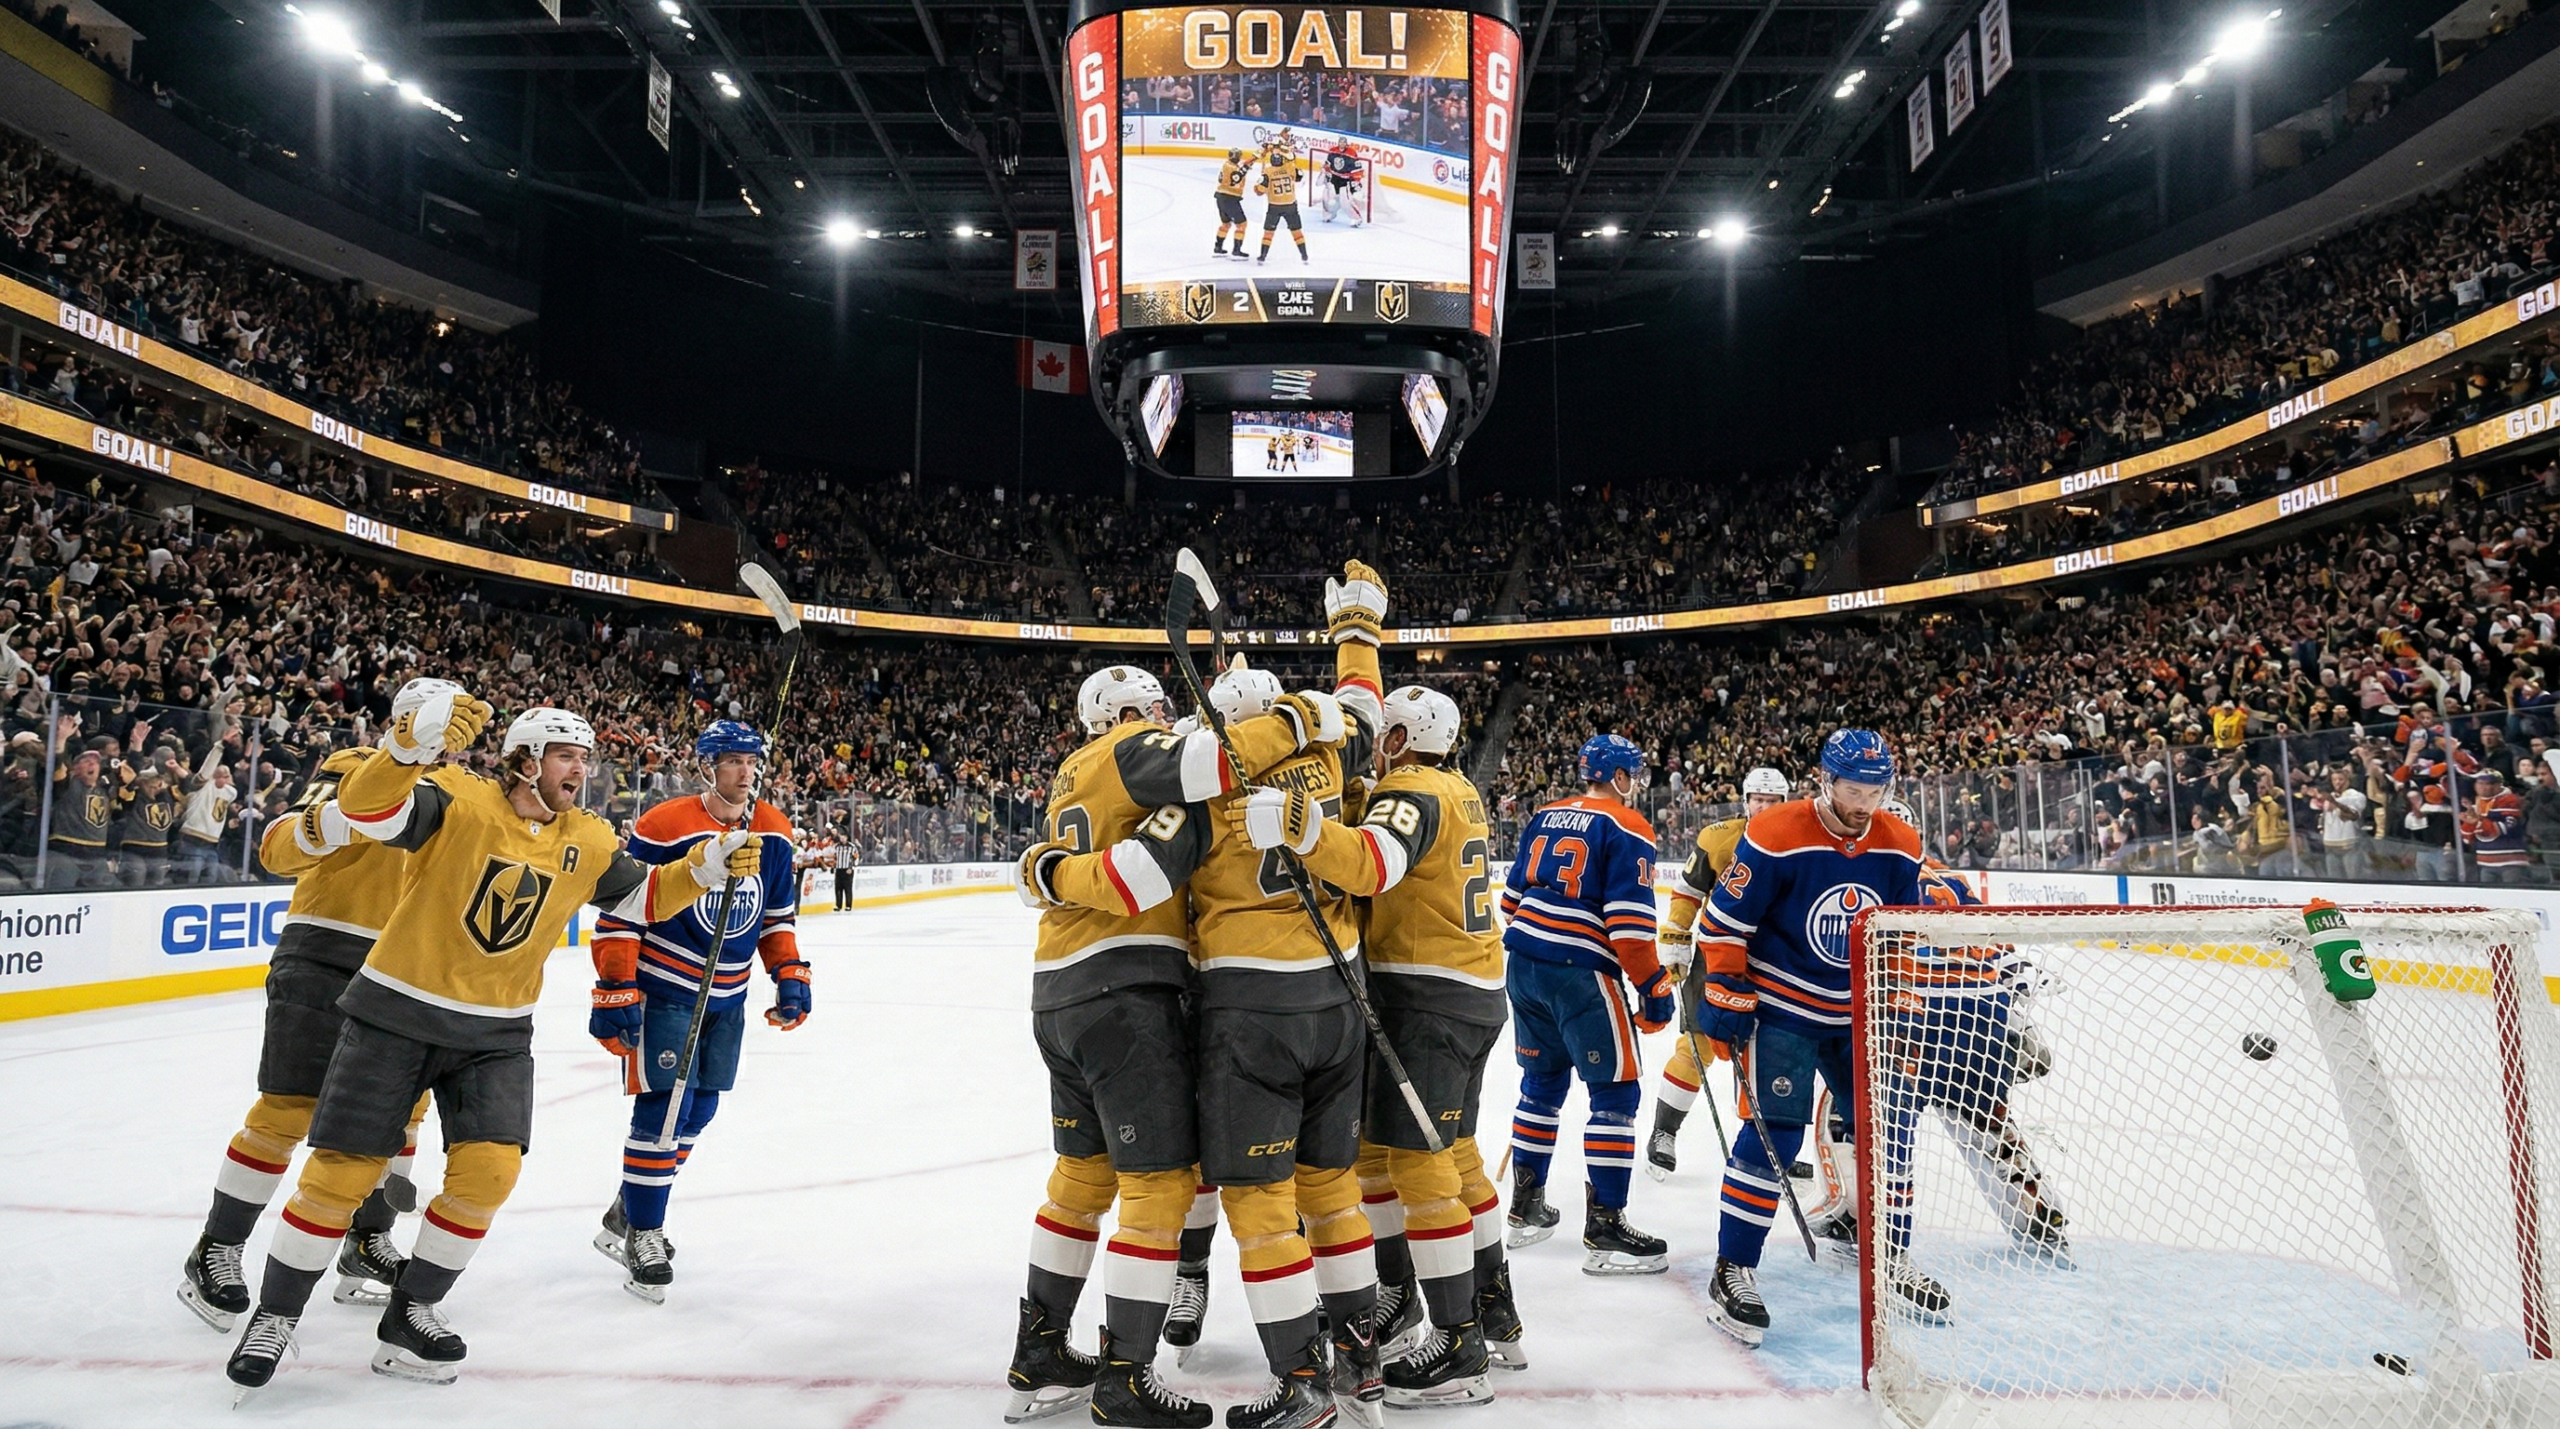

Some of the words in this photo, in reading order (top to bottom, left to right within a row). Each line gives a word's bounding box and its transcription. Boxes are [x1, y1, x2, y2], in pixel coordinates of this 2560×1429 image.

[1183, 9, 1408, 70] GOAL!
[1078, 51, 1115, 308] GOAL!
[1478, 51, 1511, 308] GOAL!
[1233, 292, 1249, 312] 2
[1342, 292, 1353, 312] 1
[2518, 280, 2560, 322] GO
[58, 301, 140, 359] GOAL!
[2268, 385, 2325, 430] GOAL!
[310, 411, 364, 451] GOAL!
[92, 426, 171, 475] GOAL!
[2060, 463, 2118, 495] GOAL!
[528, 482, 587, 513] GOAL!
[2277, 477, 2339, 517] GOAL!
[345, 512, 398, 548] GOAL!
[2053, 545, 2114, 575] GOAL!
[570, 568, 628, 595] GOAL!
[802, 604, 857, 625] GOAL!
[1828, 588, 1885, 612] GOAL!
[1019, 623, 1073, 641] GOAL!
[1398, 627, 1450, 643] GOAL!
[1611, 614, 1665, 633] GOAL!
[1135, 803, 1187, 842] 9
[1363, 799, 1422, 836] 28
[561, 844, 581, 875] A
[1526, 835, 1590, 899] 13
[1461, 837, 1493, 934] 2
[0, 950, 43, 976] ne
[2340, 948, 2372, 980] G
[1246, 1137, 1298, 1157] CCM
